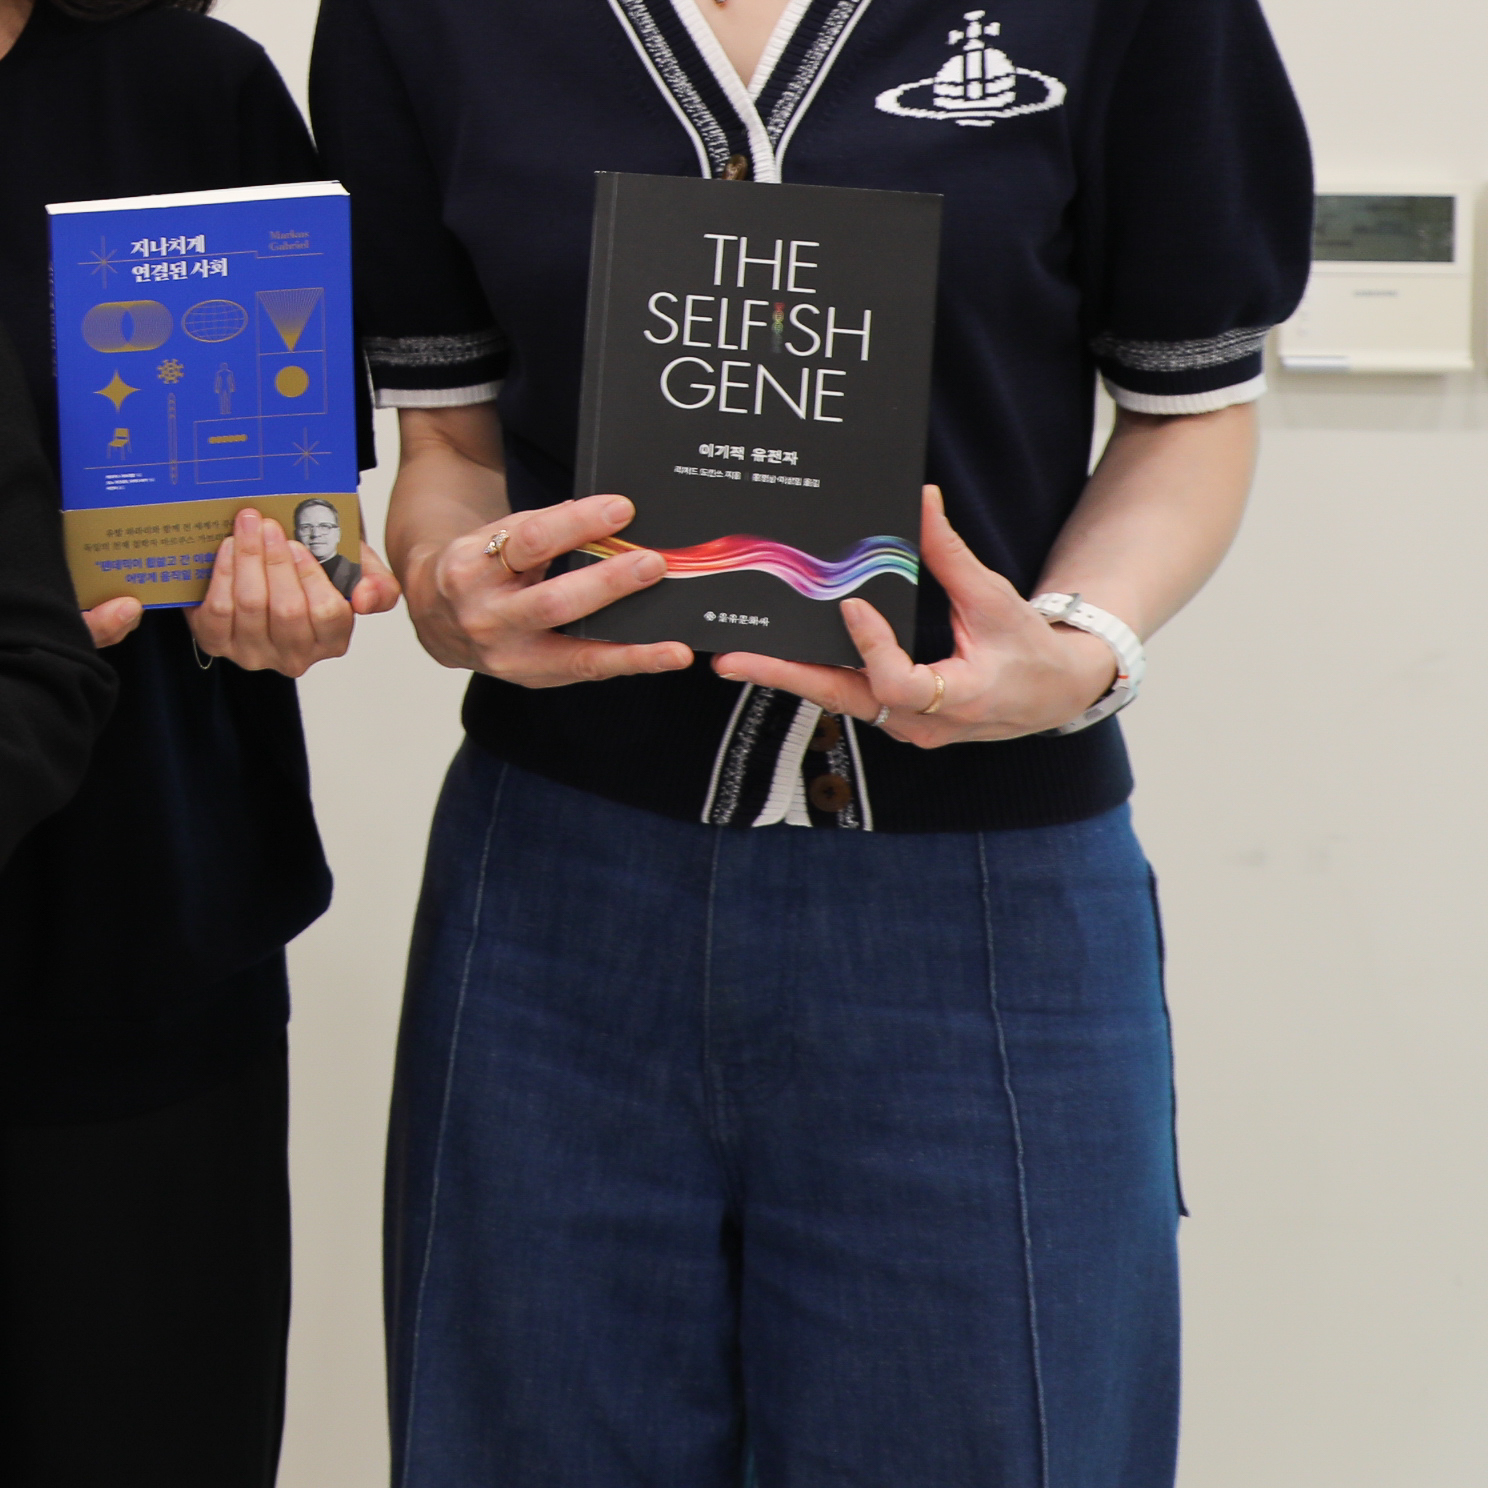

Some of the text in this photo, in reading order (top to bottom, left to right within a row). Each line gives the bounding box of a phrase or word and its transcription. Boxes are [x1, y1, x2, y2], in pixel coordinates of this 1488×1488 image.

[130, 234, 206, 258] 지나치게
[131, 257, 228, 283] 연결된 사회
[703, 233, 821, 294] THE
[660, 356, 847, 423] GENE
[698, 443, 799, 466] 이기적 유전자
